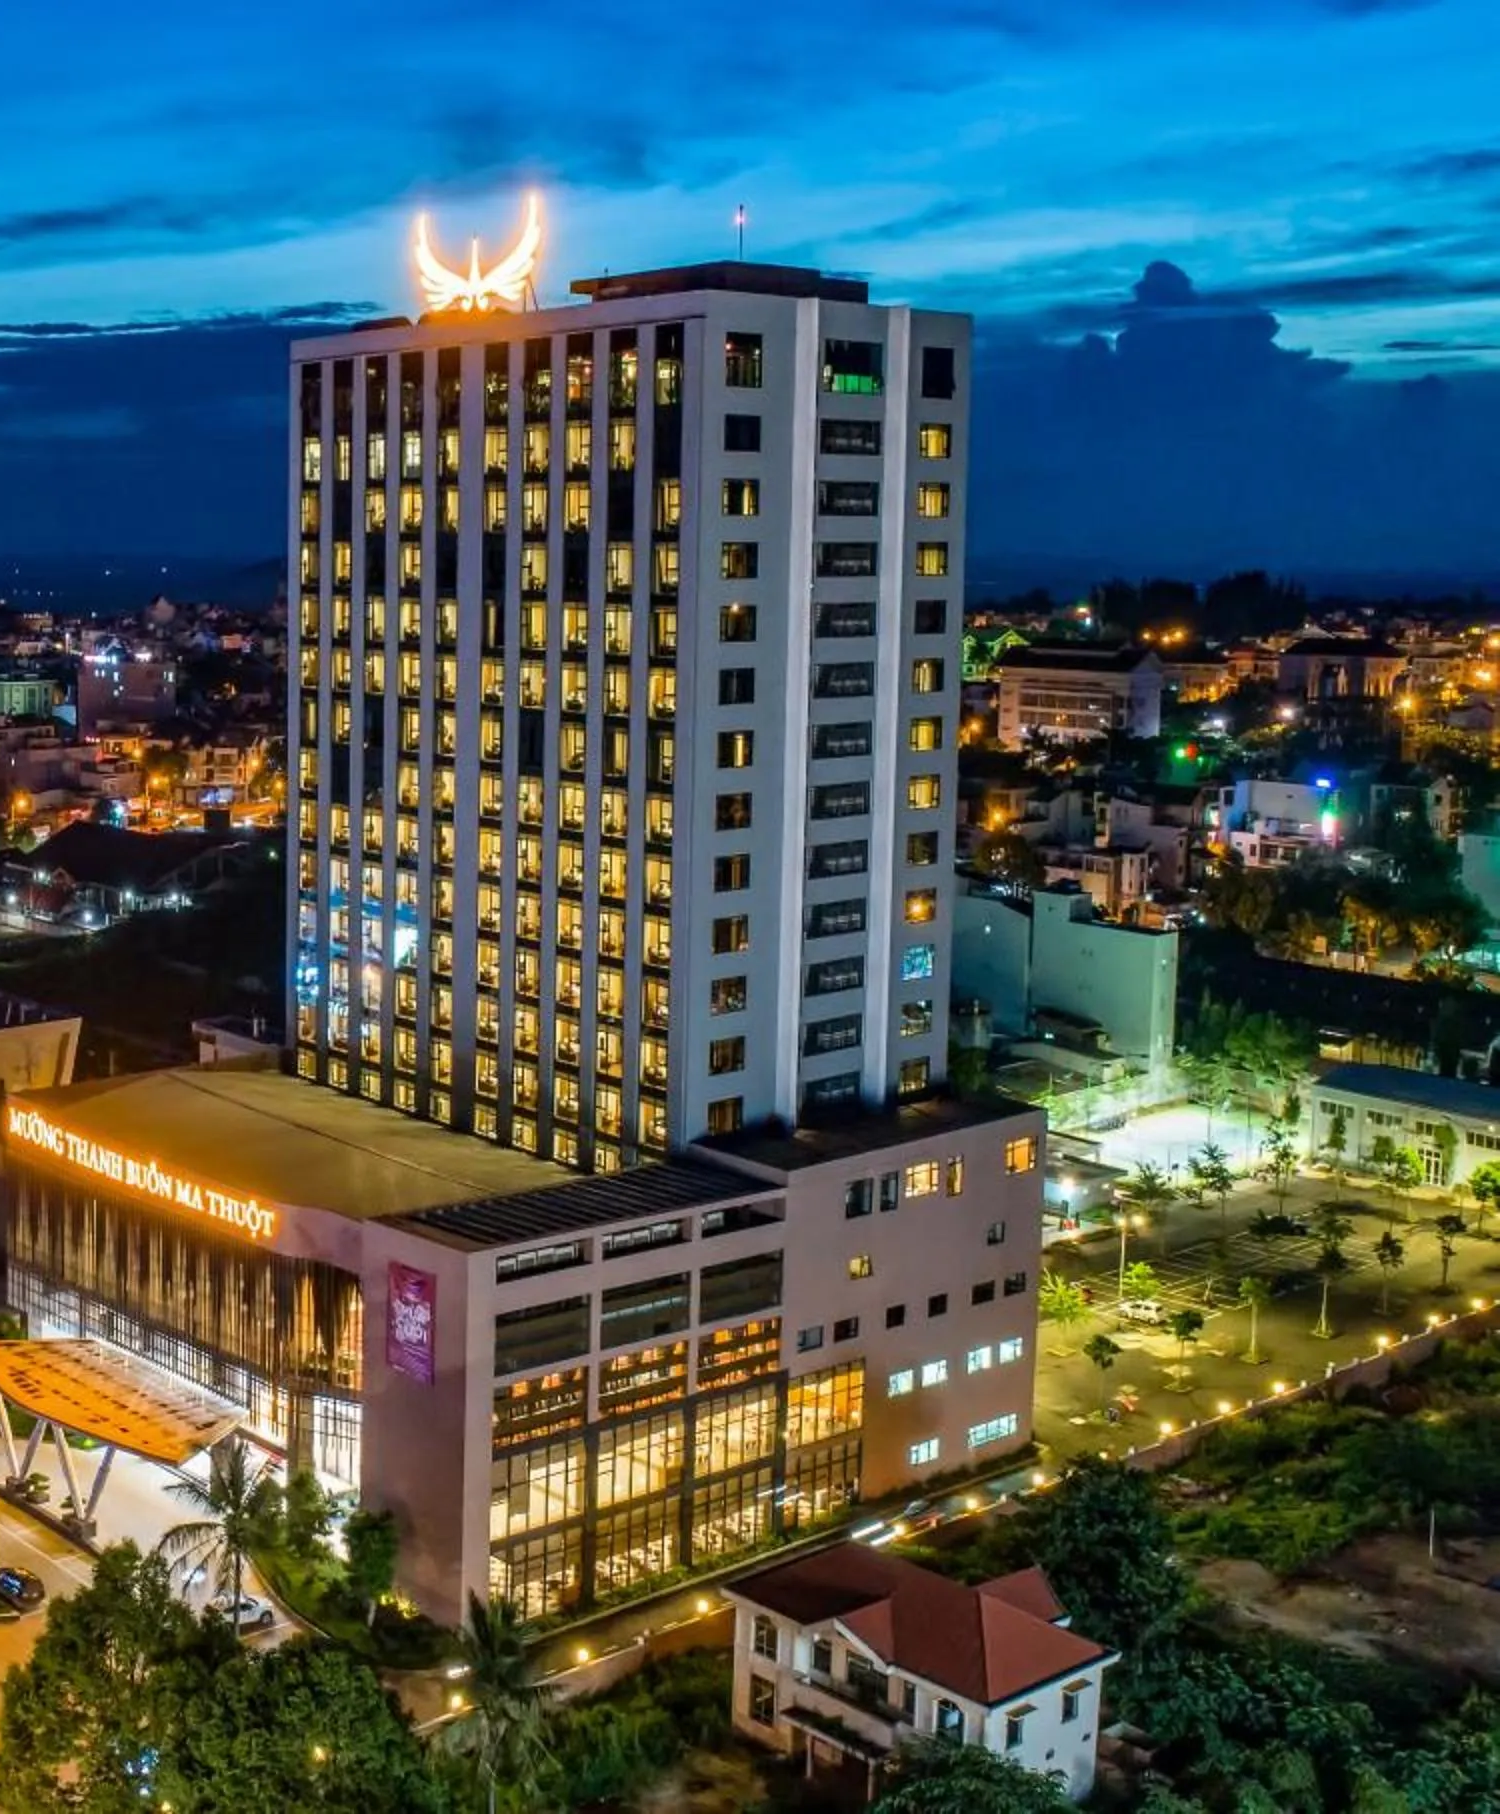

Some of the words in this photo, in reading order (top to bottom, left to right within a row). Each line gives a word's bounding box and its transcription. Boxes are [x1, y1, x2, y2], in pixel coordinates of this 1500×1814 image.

[66, 1132, 122, 1179] THANH
[125, 1159, 173, 1199] BUÔN
[174, 1178, 203, 1211] MA
[205, 1189, 276, 1239] THUỘT
